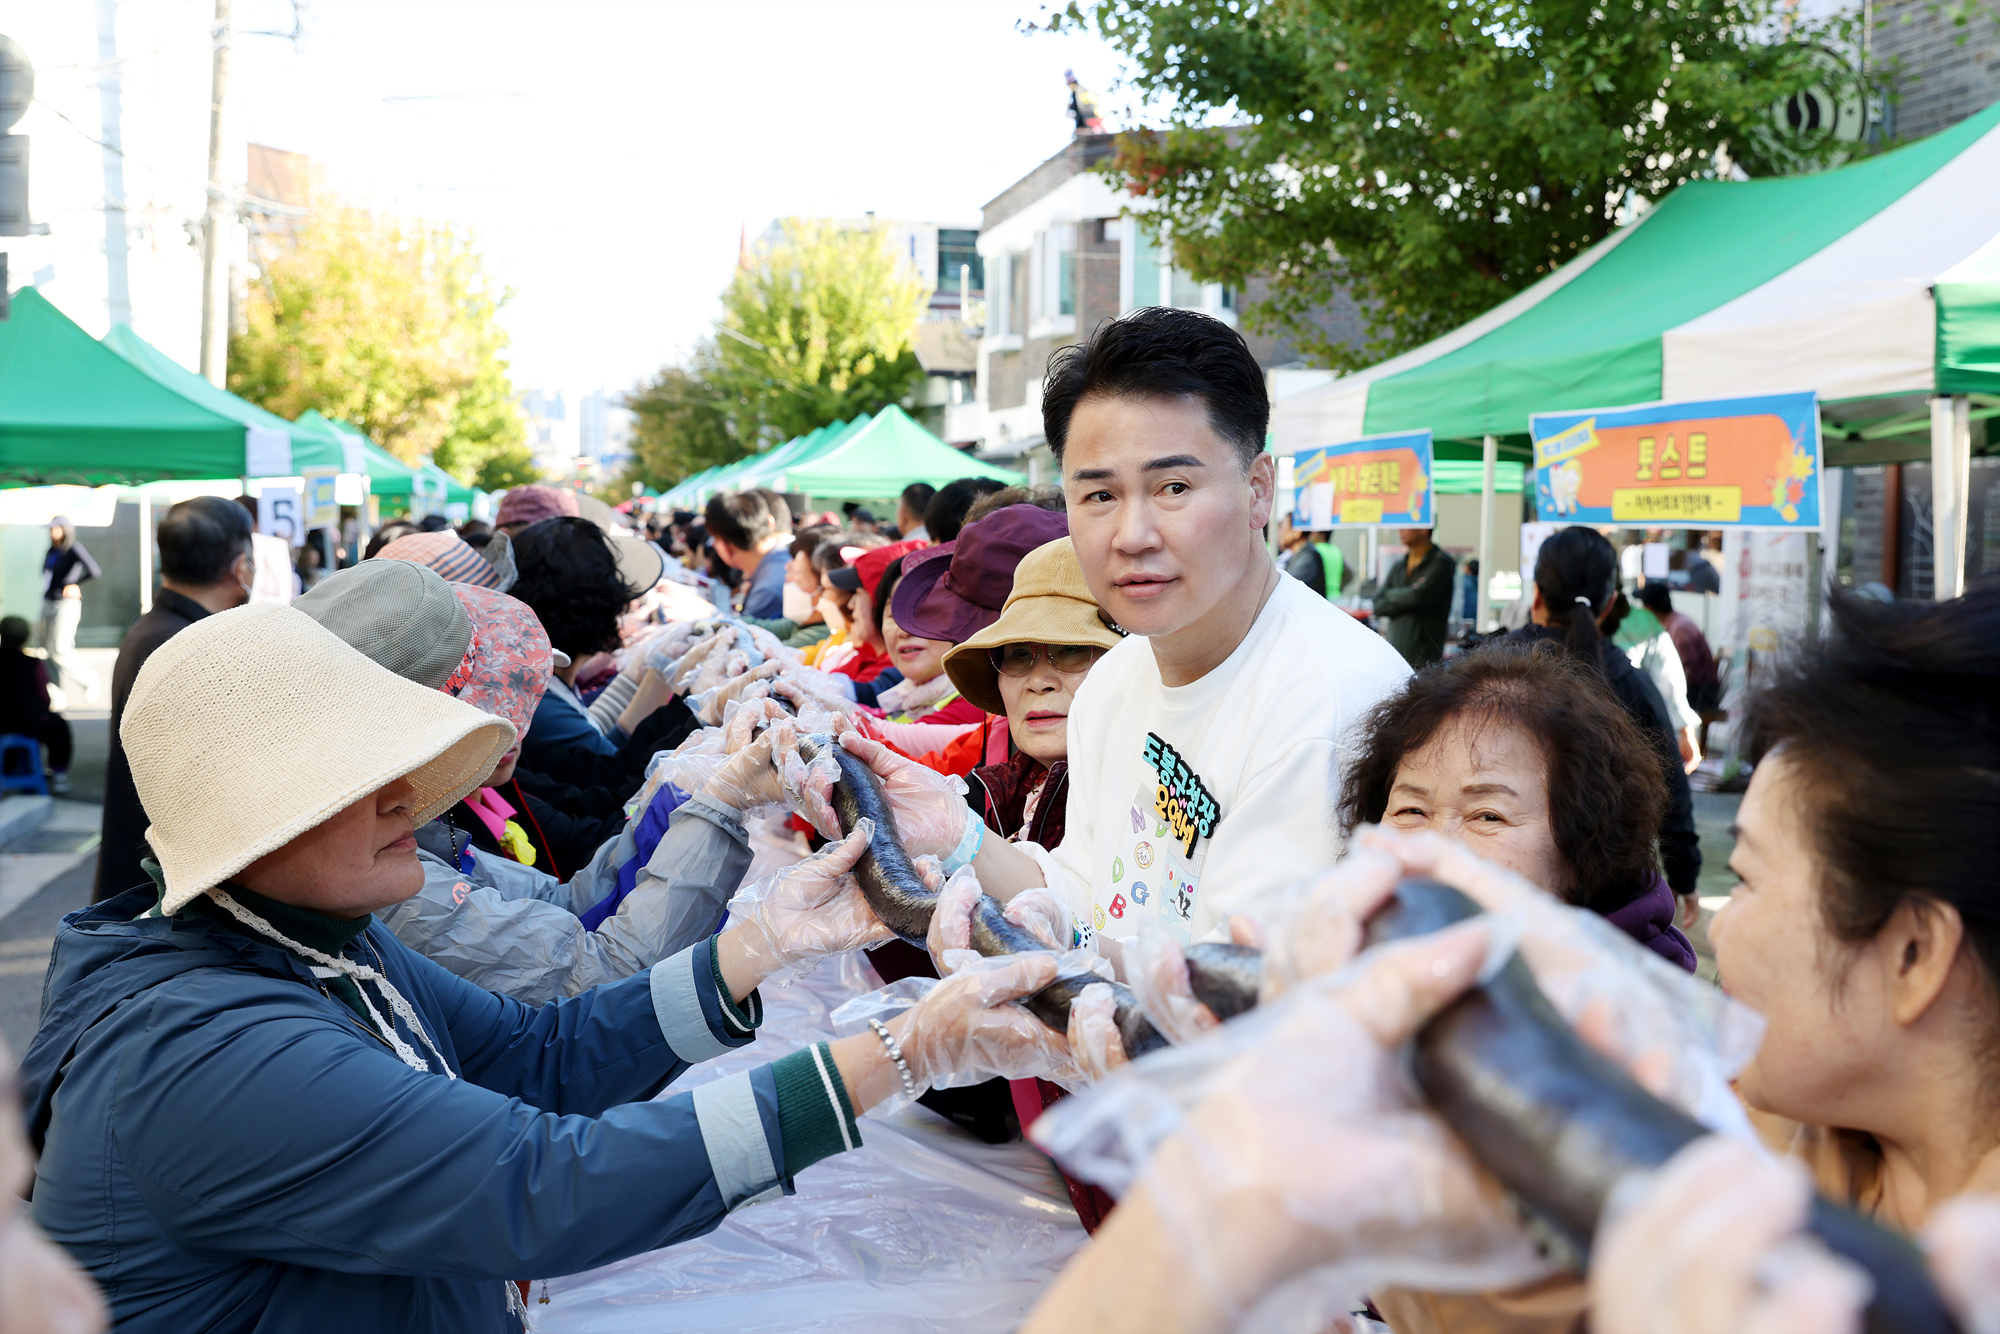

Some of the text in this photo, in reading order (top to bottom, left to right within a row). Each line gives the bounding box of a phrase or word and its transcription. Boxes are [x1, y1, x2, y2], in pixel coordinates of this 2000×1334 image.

[1635, 432, 1708, 481] 토스트
[273, 500, 296, 537] 5
[1142, 733, 1216, 837] 도봉구청장
[1154, 784, 1195, 856] 오언석
[1113, 856, 1124, 883] D
[1109, 893, 1127, 919] B
[1131, 881, 1150, 906] G
